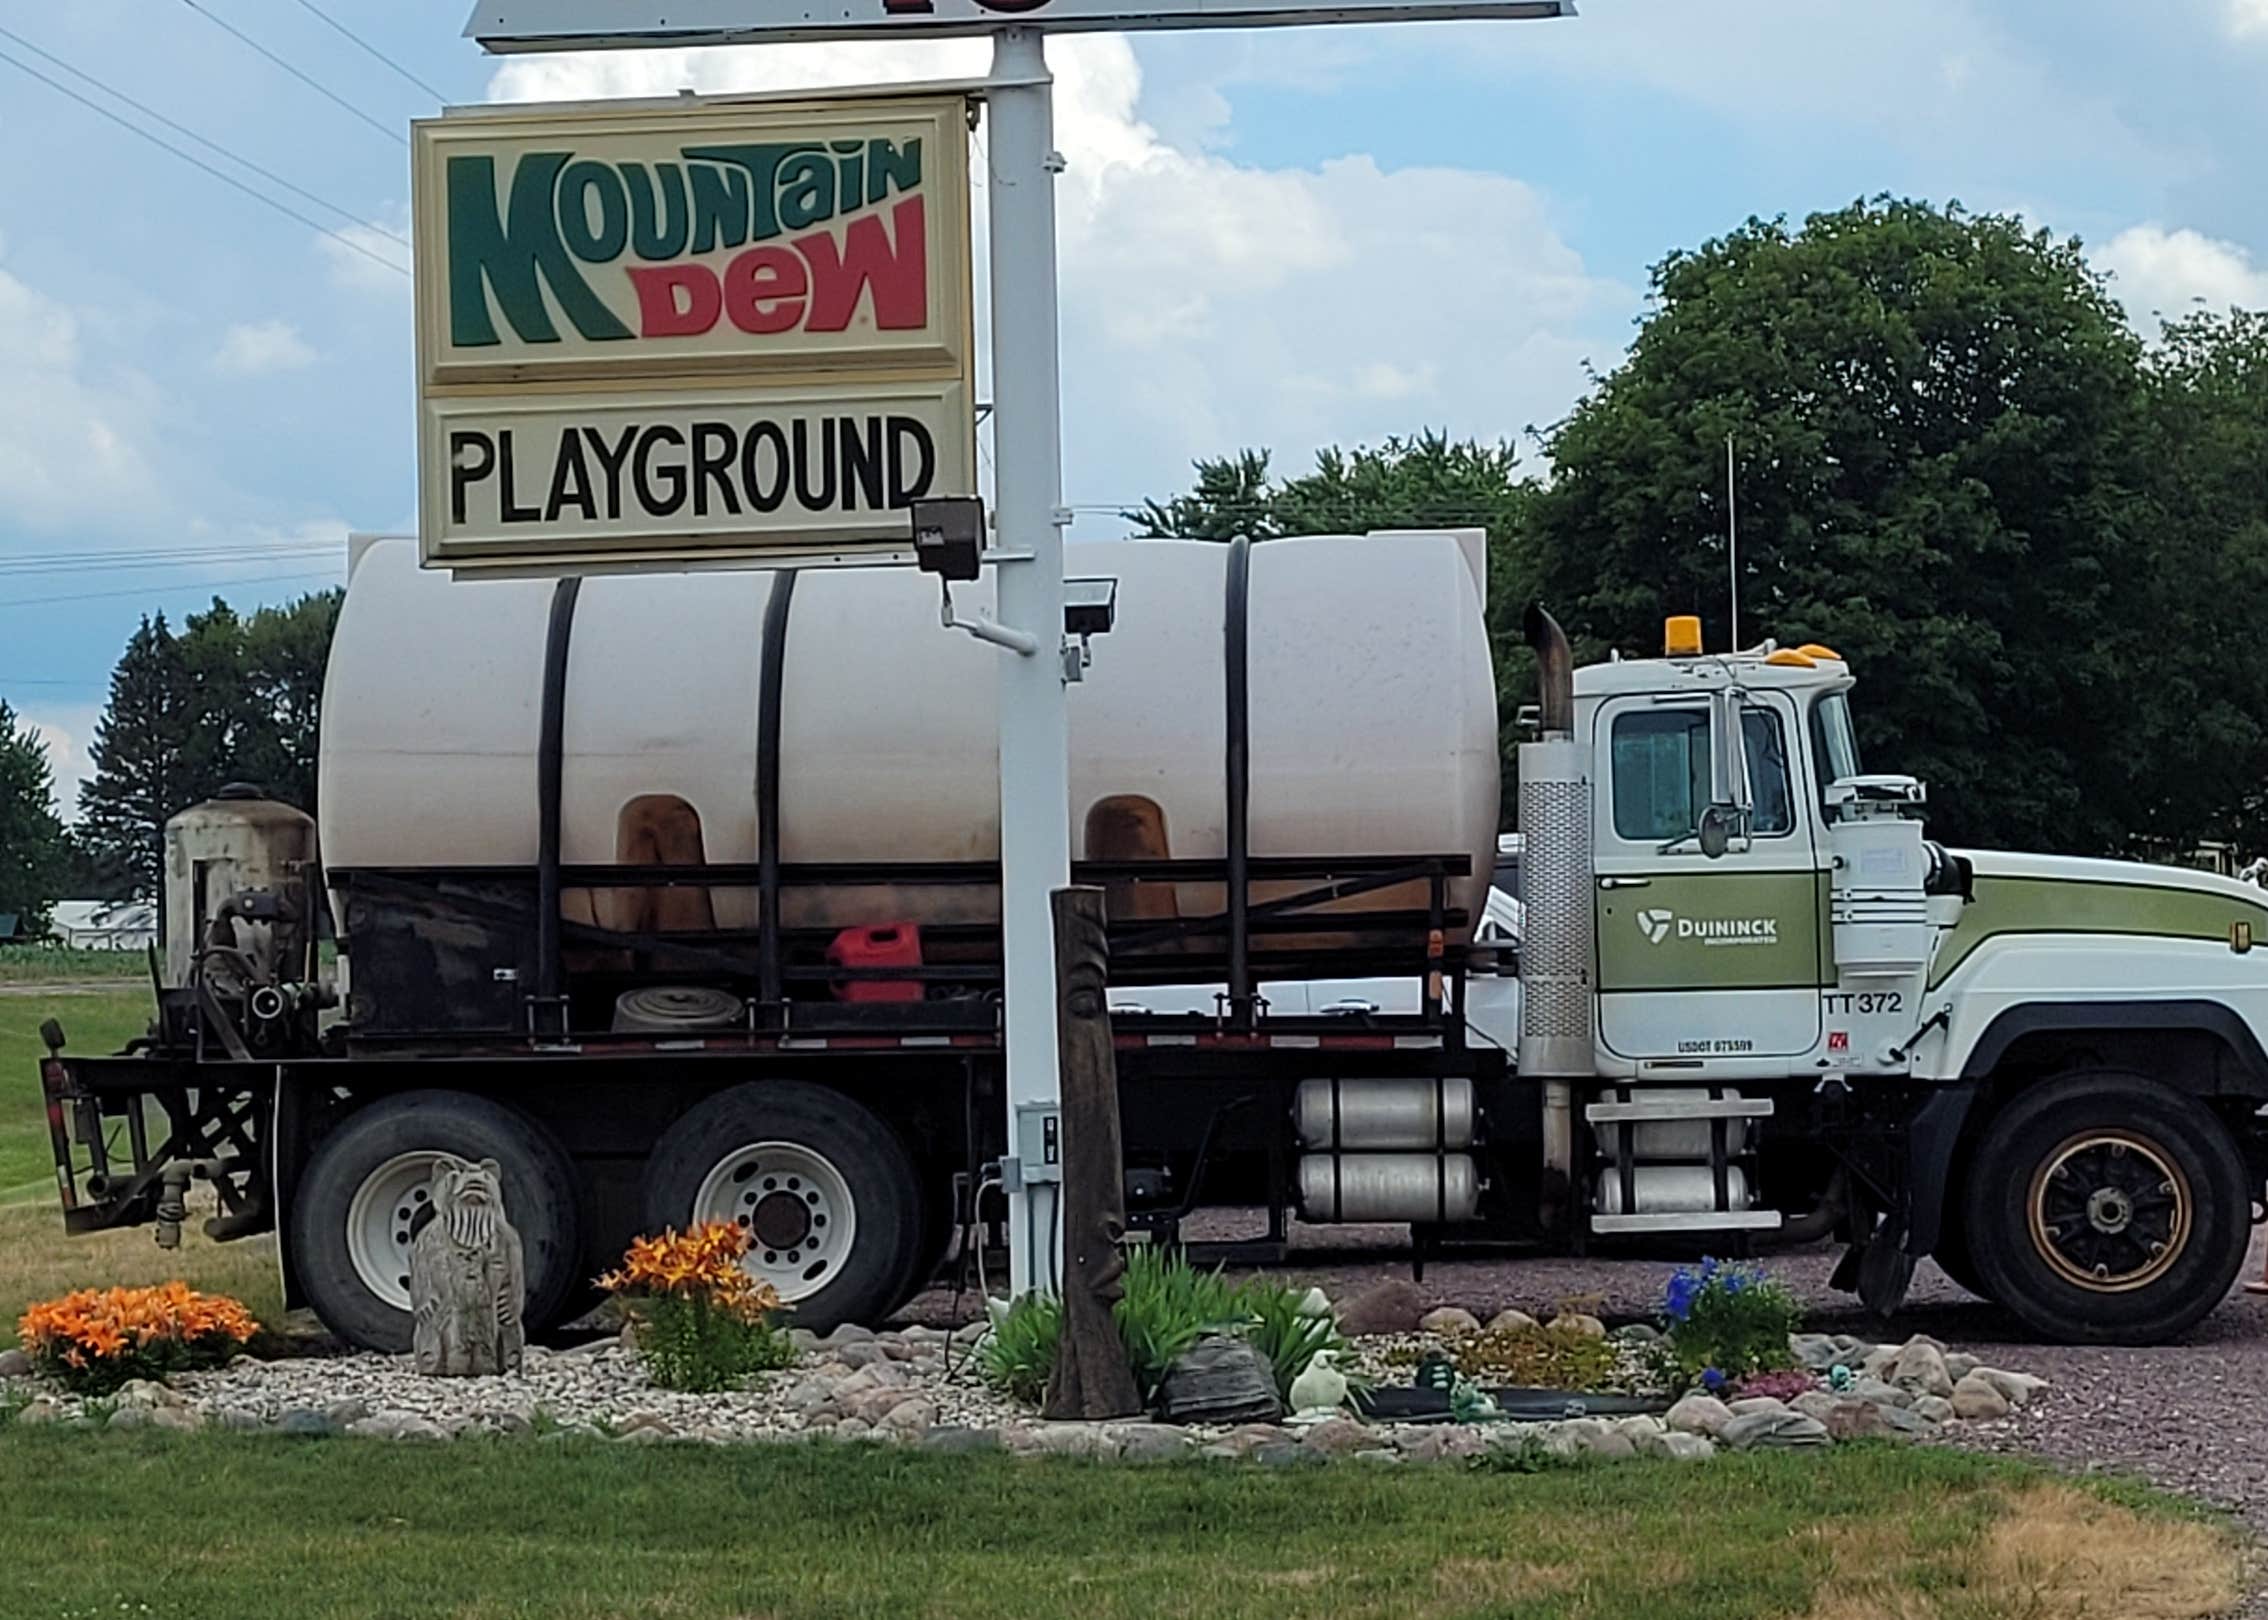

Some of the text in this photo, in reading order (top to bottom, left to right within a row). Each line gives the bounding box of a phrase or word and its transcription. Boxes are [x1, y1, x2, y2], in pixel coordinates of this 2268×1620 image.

[449, 415, 936, 525] PLAYGROUND
[1678, 918, 1777, 937] DUININCK
[1678, 1040, 1711, 1053] USDOT
